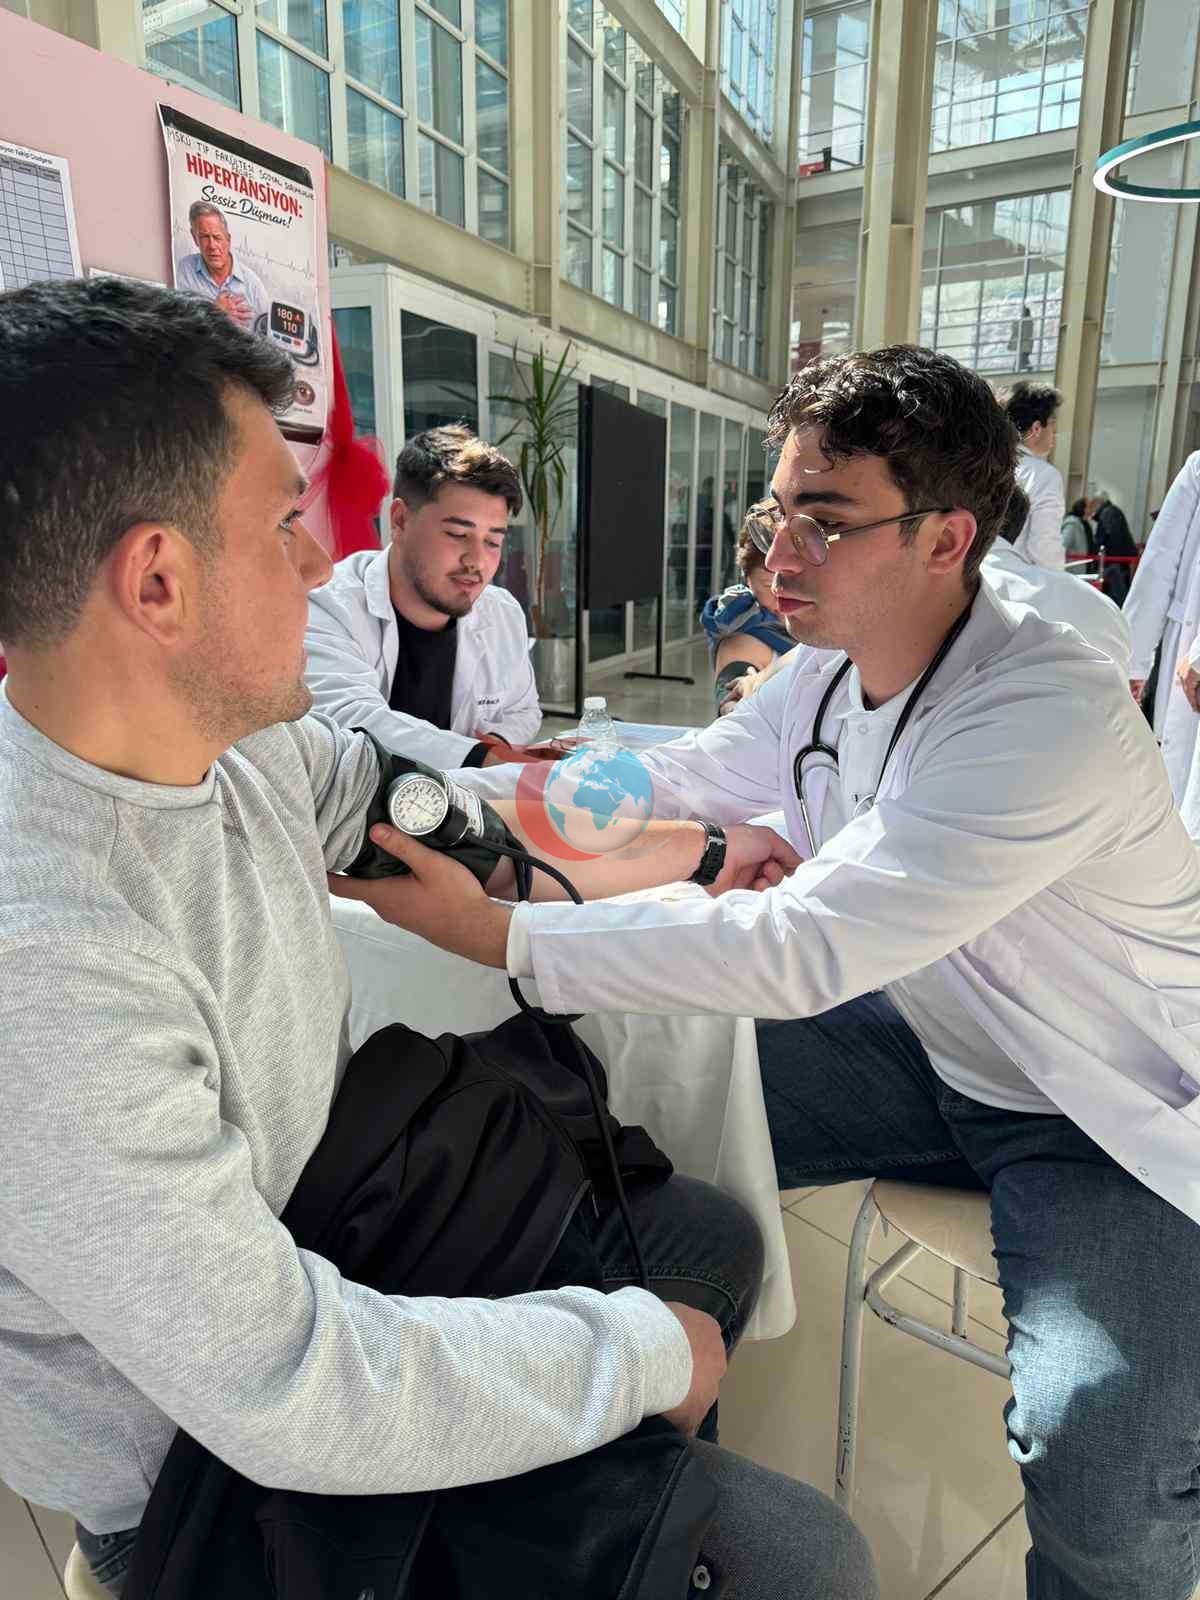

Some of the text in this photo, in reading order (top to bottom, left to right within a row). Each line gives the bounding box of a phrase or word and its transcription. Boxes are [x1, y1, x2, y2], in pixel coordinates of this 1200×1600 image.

[186, 152, 304, 218] HİPERTANSİYON:
[201, 185, 293, 228] Sessiz Düşman!
[277, 307, 293, 322] 180
[283, 320, 298, 334] 110
